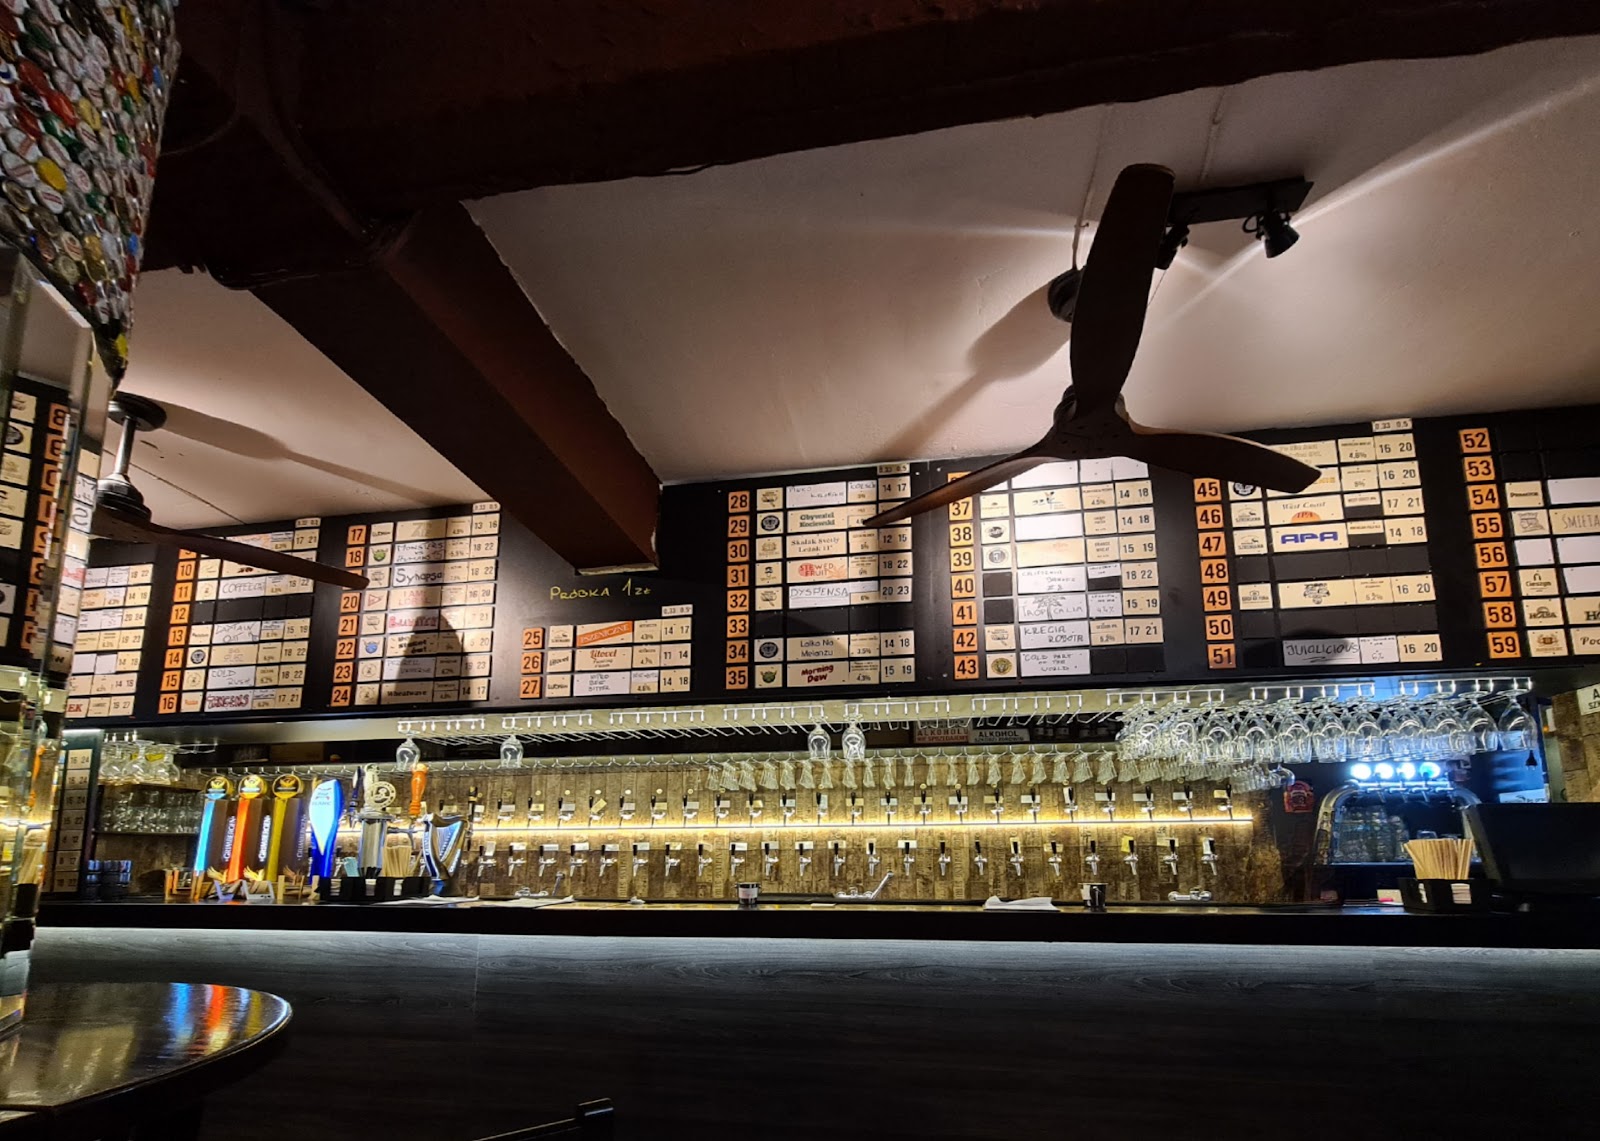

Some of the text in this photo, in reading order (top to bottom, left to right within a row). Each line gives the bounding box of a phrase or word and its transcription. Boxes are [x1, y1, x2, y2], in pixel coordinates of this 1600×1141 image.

[1463, 432, 1487, 448] 52
[1379, 444, 1391, 453] 16
[1399, 442, 1412, 452] 20
[1383, 469, 1416, 479] 16 20
[1468, 460, 1492, 477] 53
[882, 483, 907, 492] 14 17
[1119, 490, 1130, 498] 14
[1138, 488, 1149, 497] 18
[1197, 482, 1218, 497] 45
[731, 495, 748, 509] 28
[1388, 497, 1420, 508] 17 21
[1472, 488, 1496, 505] 54
[952, 501, 970, 516] 37
[1122, 515, 1150, 525] 14 18
[1199, 509, 1221, 524] 46
[730, 519, 747, 533] 29
[1390, 526, 1423, 537] 14 18
[1476, 517, 1500, 534] 55
[351, 528, 363, 541] 17
[884, 535, 892, 543] 12
[899, 534, 907, 542] 15
[952, 527, 972, 541] 38
[1281, 531, 1338, 544] APA
[1123, 543, 1153, 553] 15 19
[1202, 536, 1222, 552] 47
[349, 551, 362, 563] 18
[730, 545, 747, 558] 30
[1480, 546, 1504, 563] 56
[883, 561, 893, 569] 18
[897, 560, 908, 568] 22
[953, 552, 972, 566] 39
[180, 564, 192, 576] 10
[484, 567, 493, 575] 22
[731, 569, 746, 582] 31
[1126, 570, 1153, 579] 18 22
[1204, 564, 1226, 579] 48
[882, 586, 909, 595] 20 23
[954, 579, 974, 593] 40
[1397, 583, 1431, 594] 16 20
[1485, 576, 1507, 592] 57
[178, 586, 188, 597] 11
[343, 596, 357, 609] 20
[730, 594, 747, 608] 32
[1127, 599, 1157, 608] 15 19
[1207, 591, 1228, 606] 49
[175, 608, 186, 620] 12
[956, 605, 974, 619] 41
[1488, 606, 1513, 623] 58
[341, 619, 354, 632] 21
[664, 626, 689, 635] 14 17
[730, 619, 747, 633] 33
[1129, 626, 1157, 636] 17 21
[1209, 620, 1231, 635] 50
[172, 630, 183, 642] 13
[525, 632, 540, 645] 25
[956, 632, 975, 647] 42
[338, 642, 353, 655] 22
[884, 638, 910, 648] 14 18
[1403, 642, 1437, 653] 16 20
[1492, 636, 1516, 654] 59
[169, 652, 180, 664] 14
[679, 650, 688, 658] 14
[728, 644, 746, 659] 34
[1213, 649, 1232, 664] 51
[523, 656, 539, 670] 26
[957, 660, 976, 675] 43
[336, 665, 351, 679] 23
[801, 664, 834, 676] Morning
[885, 665, 912, 675] 15 19
[166, 675, 177, 687] 15
[663, 676, 688, 686] 14 18
[728, 671, 746, 685] 35
[807, 673, 828, 683] Dew
[462, 687, 470, 695] 14
[522, 680, 539, 694] 27
[333, 689, 348, 702] 24
[162, 697, 175, 710] 16
